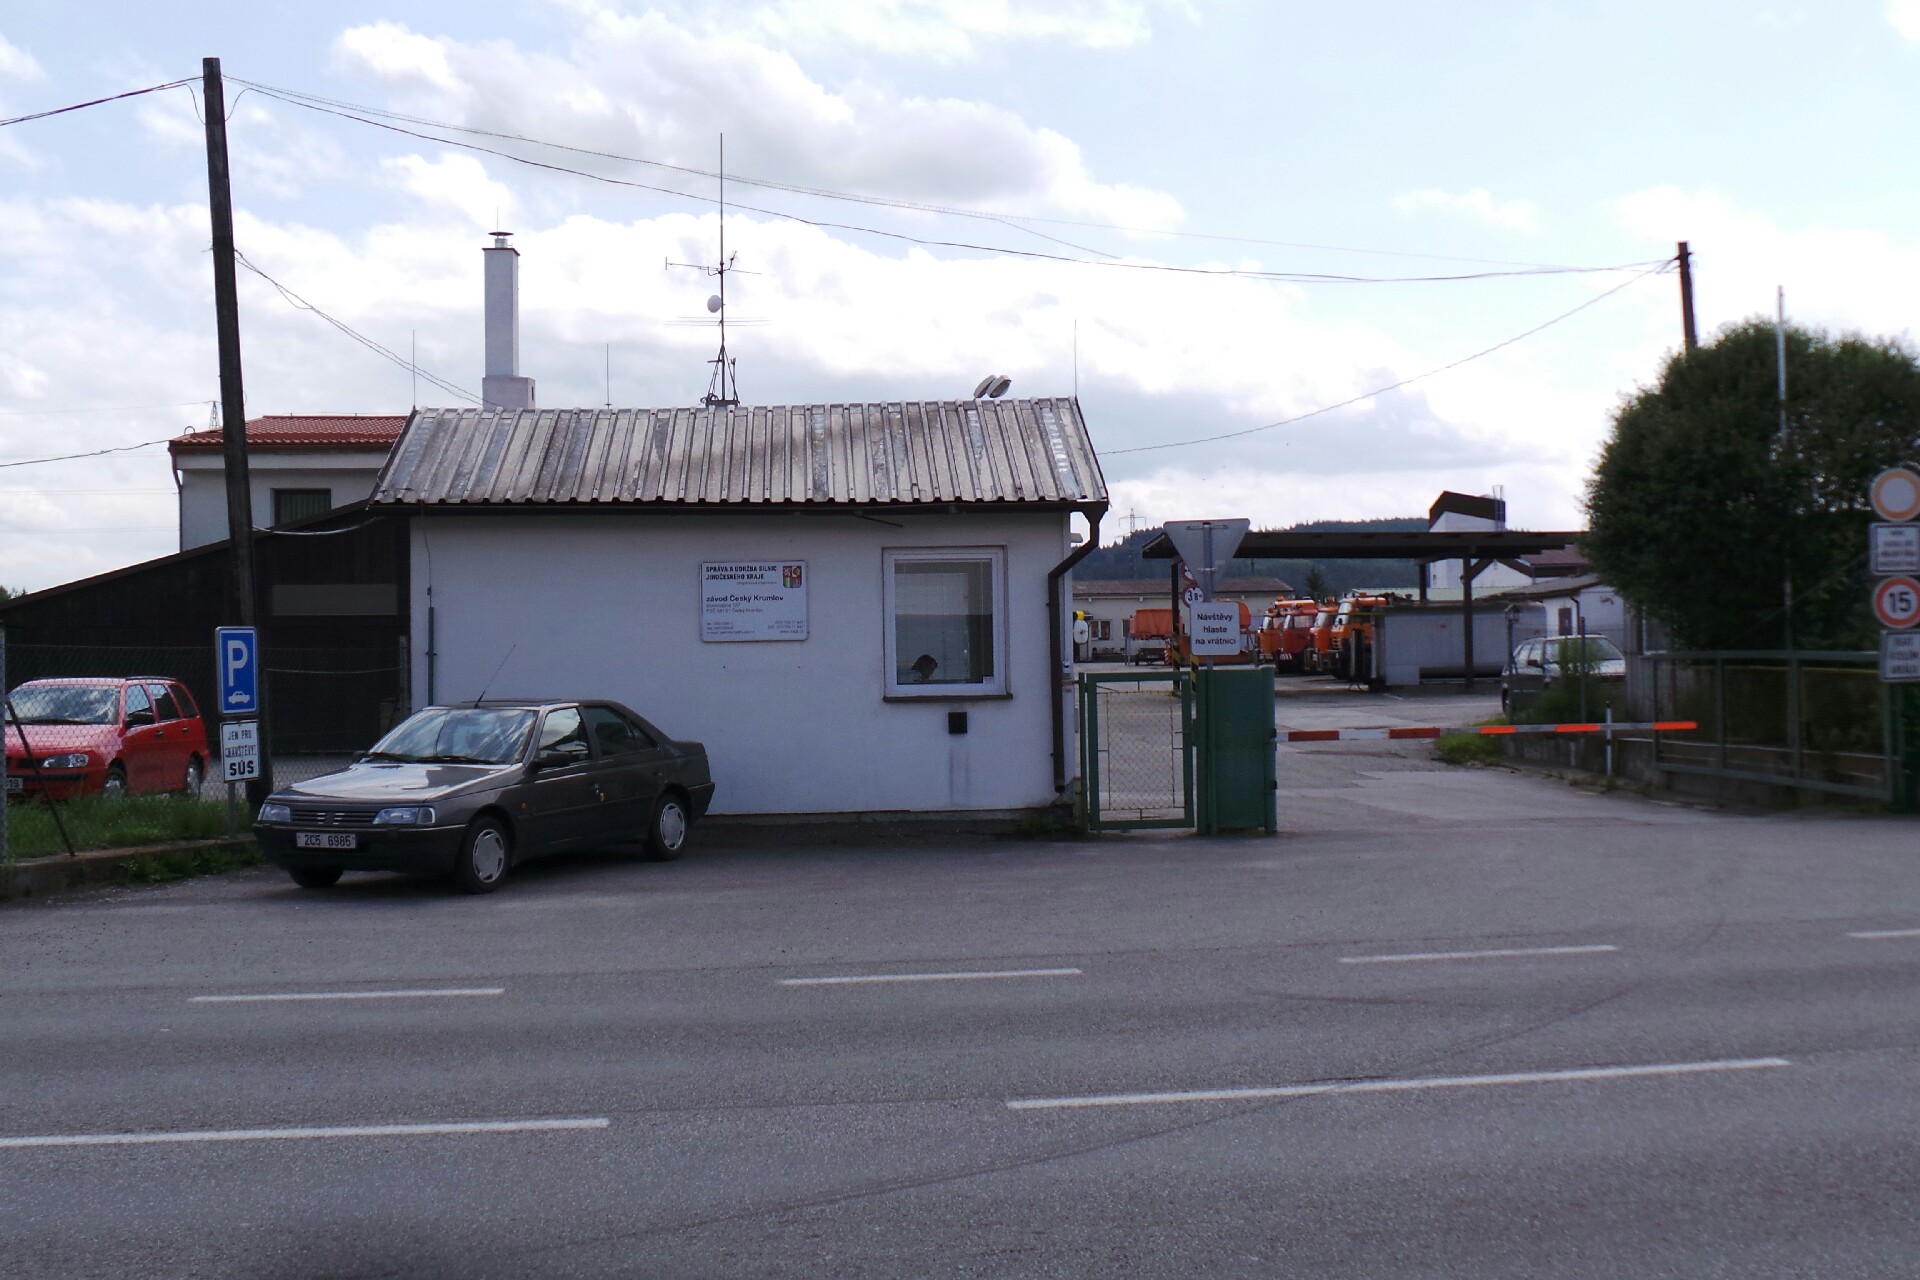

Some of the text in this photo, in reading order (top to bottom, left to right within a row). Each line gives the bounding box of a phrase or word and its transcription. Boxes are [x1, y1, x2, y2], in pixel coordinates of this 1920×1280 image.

[705, 564, 728, 572] SPRÁVA
[729, 594, 752, 603] Český
[1889, 592, 1911, 613] 15
[1197, 613, 1233, 622] Návštěvy
[227, 640, 248, 687] P
[228, 729, 252, 741] JEN PRO
[229, 760, 255, 776] SÚS
[304, 834, 352, 847] 2C5 6985
